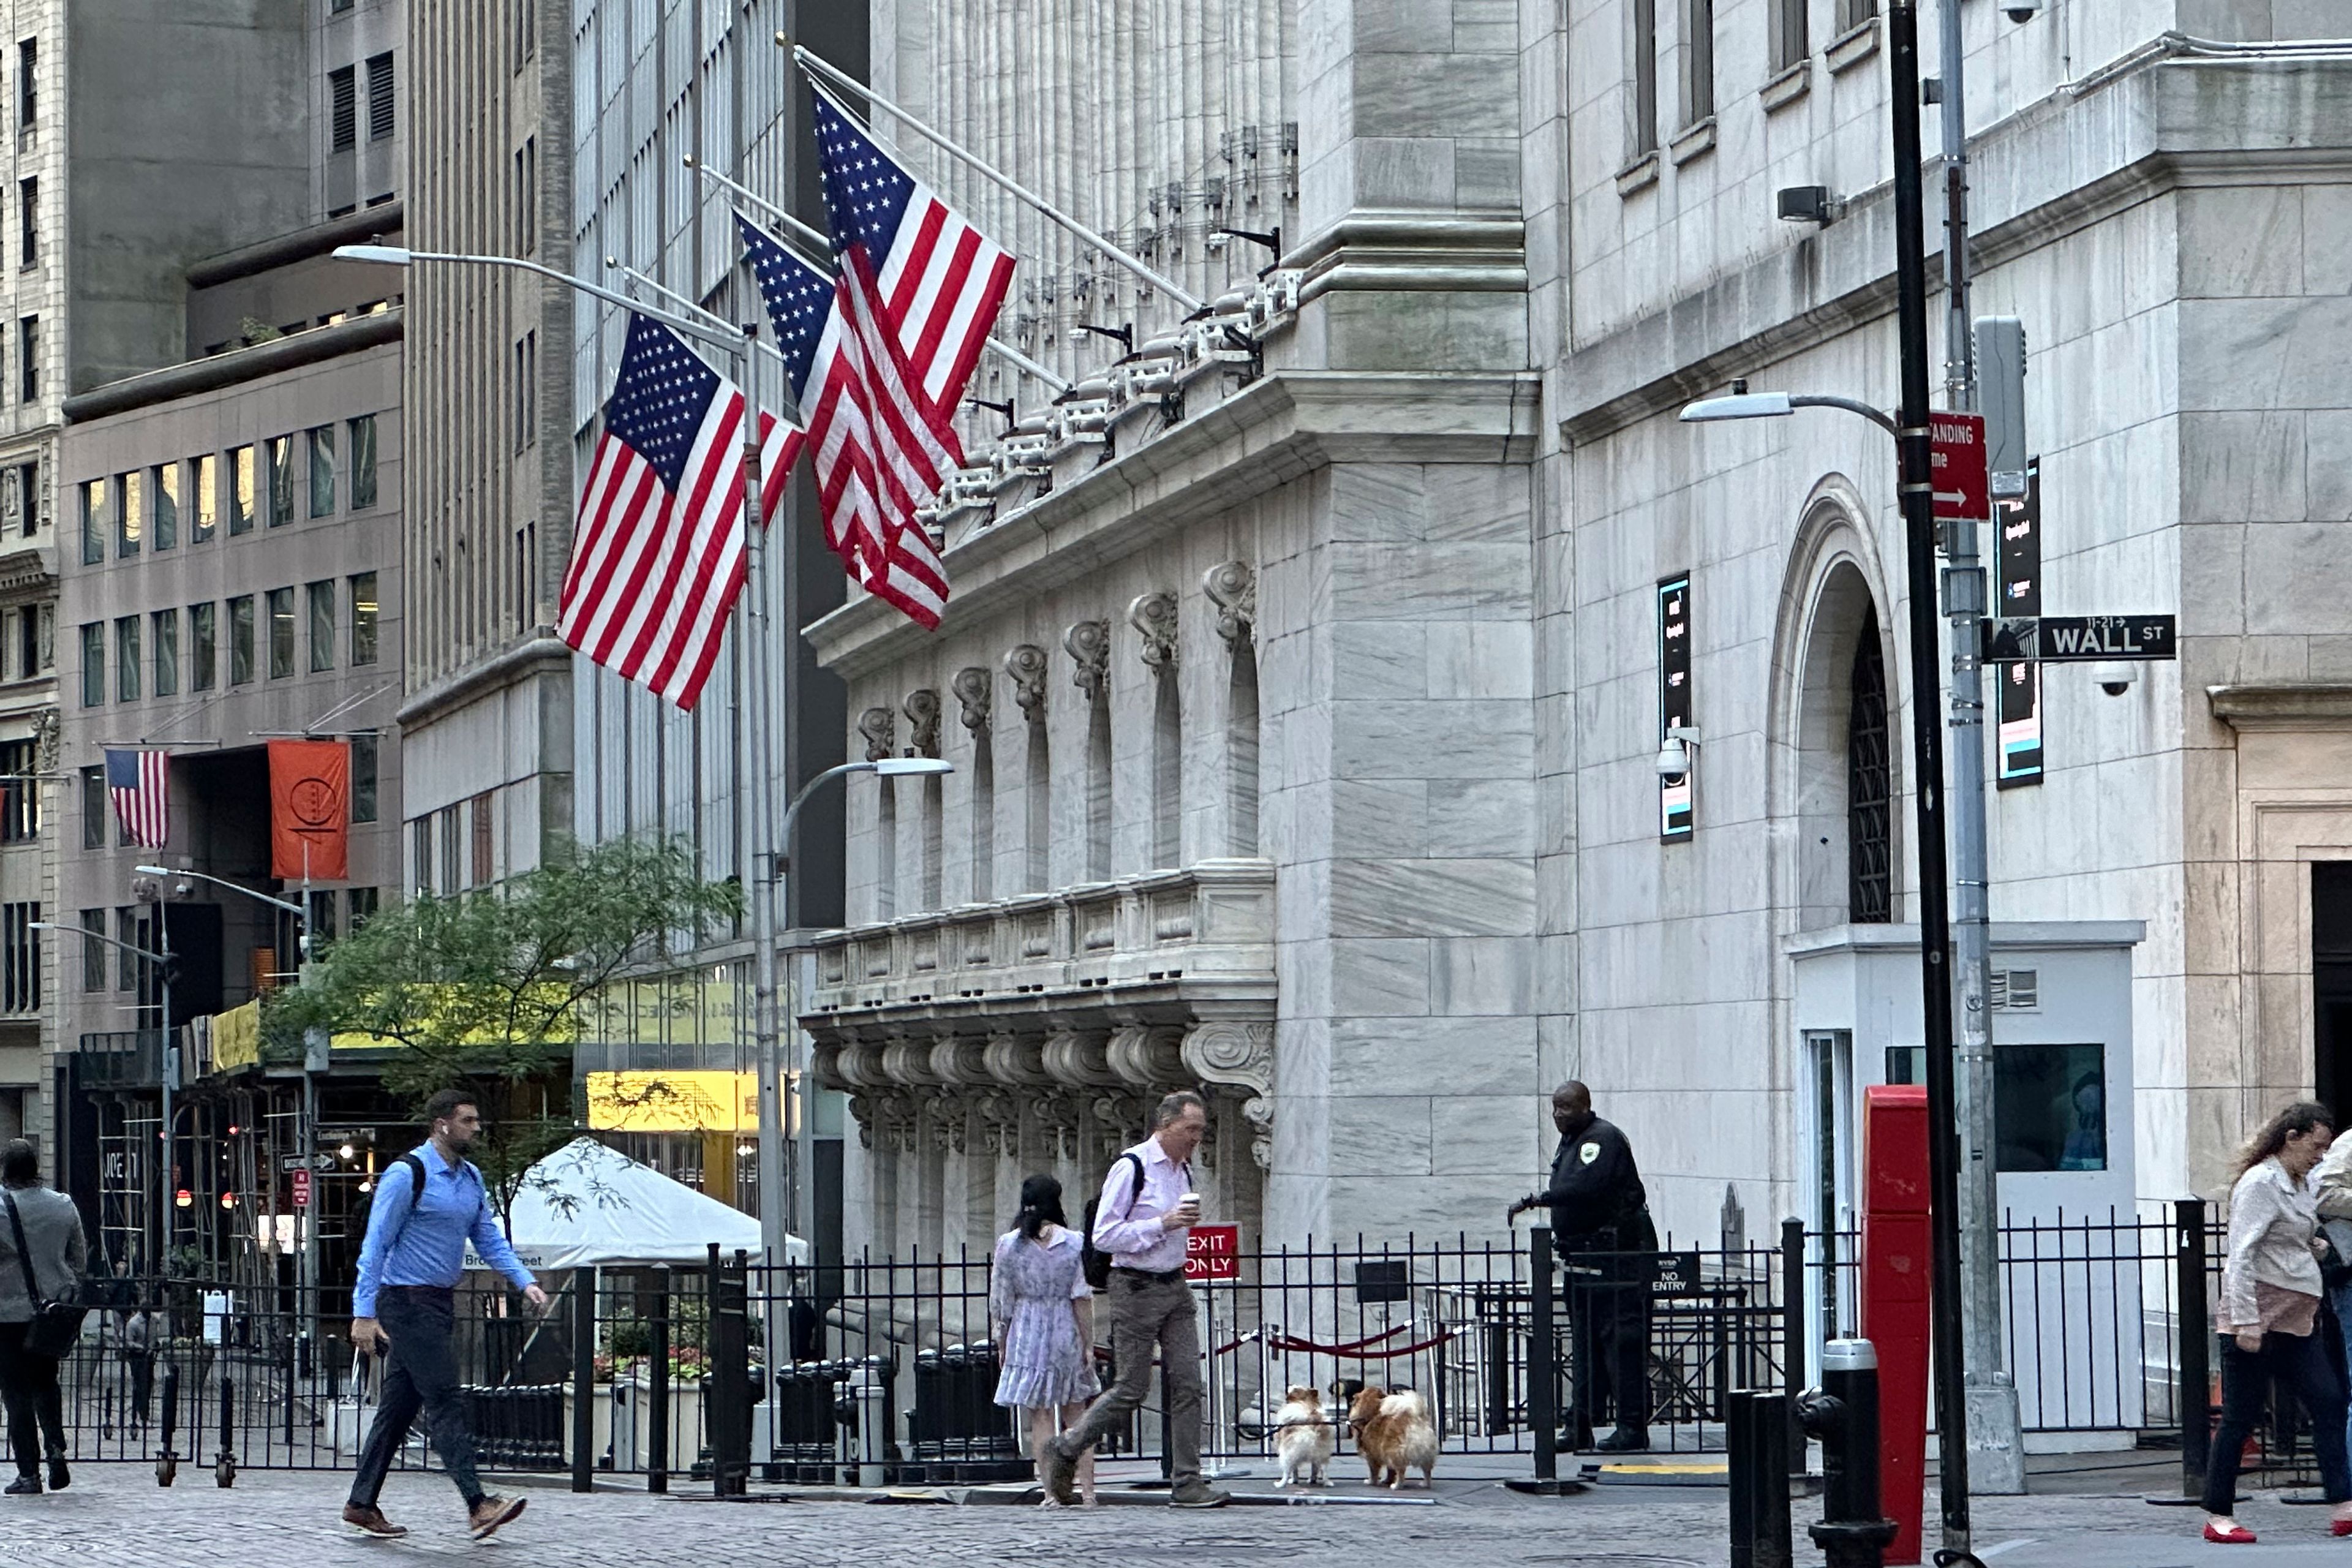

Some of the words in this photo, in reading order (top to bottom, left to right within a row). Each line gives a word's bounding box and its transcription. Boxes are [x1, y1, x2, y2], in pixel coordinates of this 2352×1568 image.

[1929, 423, 1973, 444] ANDING
[2086, 617, 2113, 628] 11-21
[2052, 627, 2143, 654] WALL
[2143, 626, 2164, 640] ST
[1187, 1235, 1225, 1251] EXIT
[1185, 1257, 1231, 1273] ONLY
[1661, 1272, 1678, 1281] NO
[1653, 1281, 1687, 1291] ENTRY
